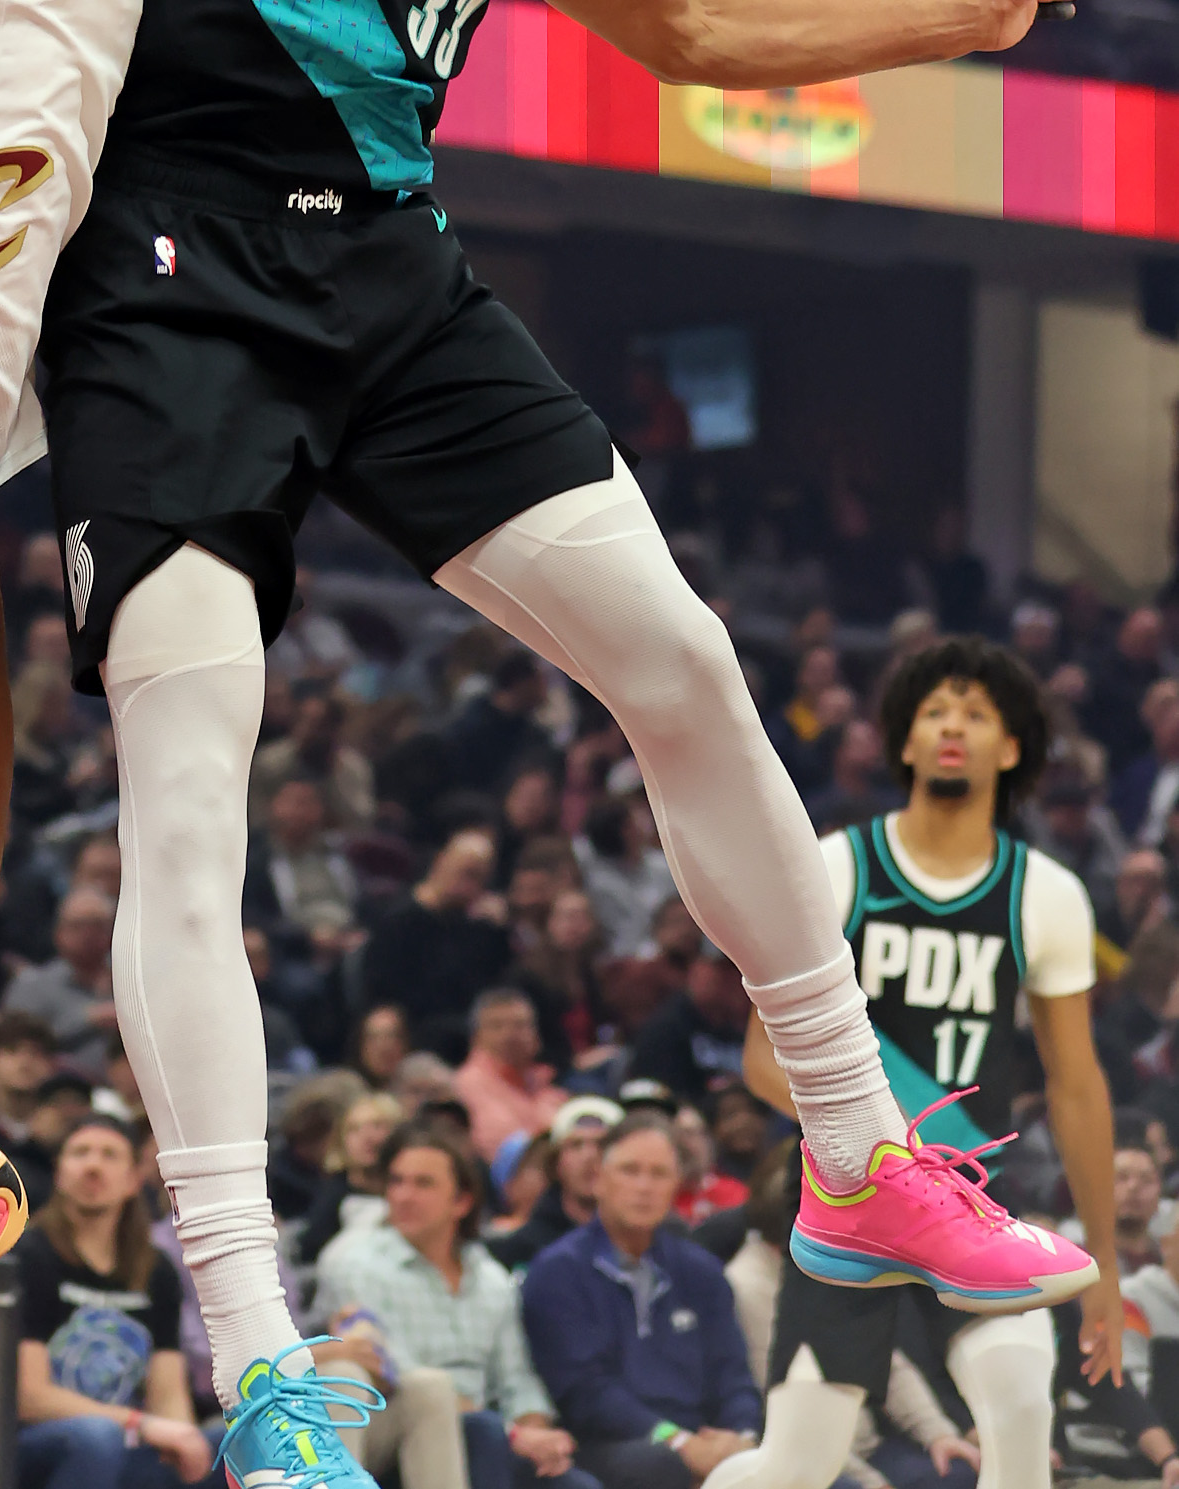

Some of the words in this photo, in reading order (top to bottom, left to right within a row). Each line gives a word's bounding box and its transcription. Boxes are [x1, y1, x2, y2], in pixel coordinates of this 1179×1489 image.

[287, 187, 343, 215] ripcity
[860, 921, 1006, 1014] PDX
[933, 1019, 990, 1087] 17
